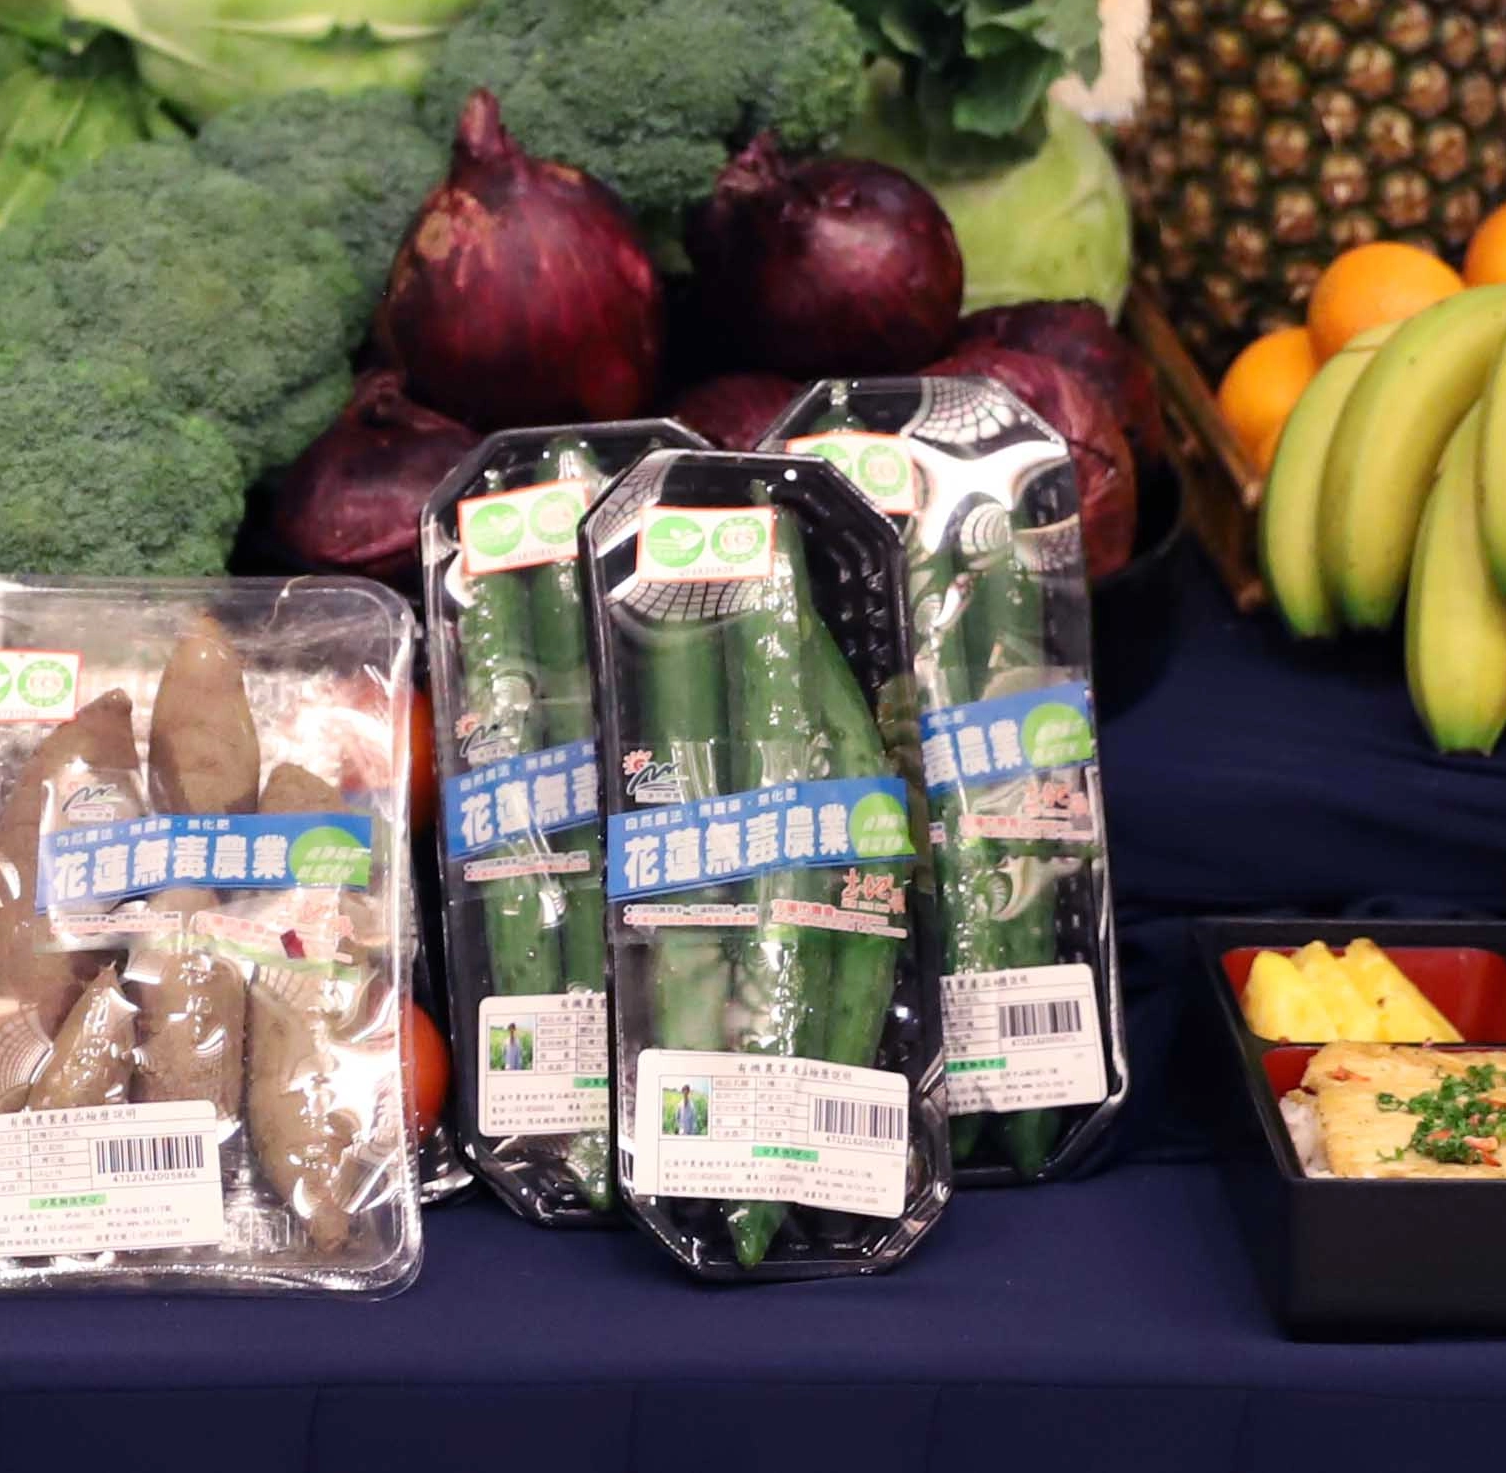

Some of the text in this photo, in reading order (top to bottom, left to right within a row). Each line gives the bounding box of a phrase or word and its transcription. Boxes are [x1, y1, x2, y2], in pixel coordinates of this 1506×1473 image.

[52, 833, 288, 900] 花蓮無毒農業
[624, 803, 849, 889] 花蓮無毒農業
[112, 1170, 198, 1183] 4712162005866
